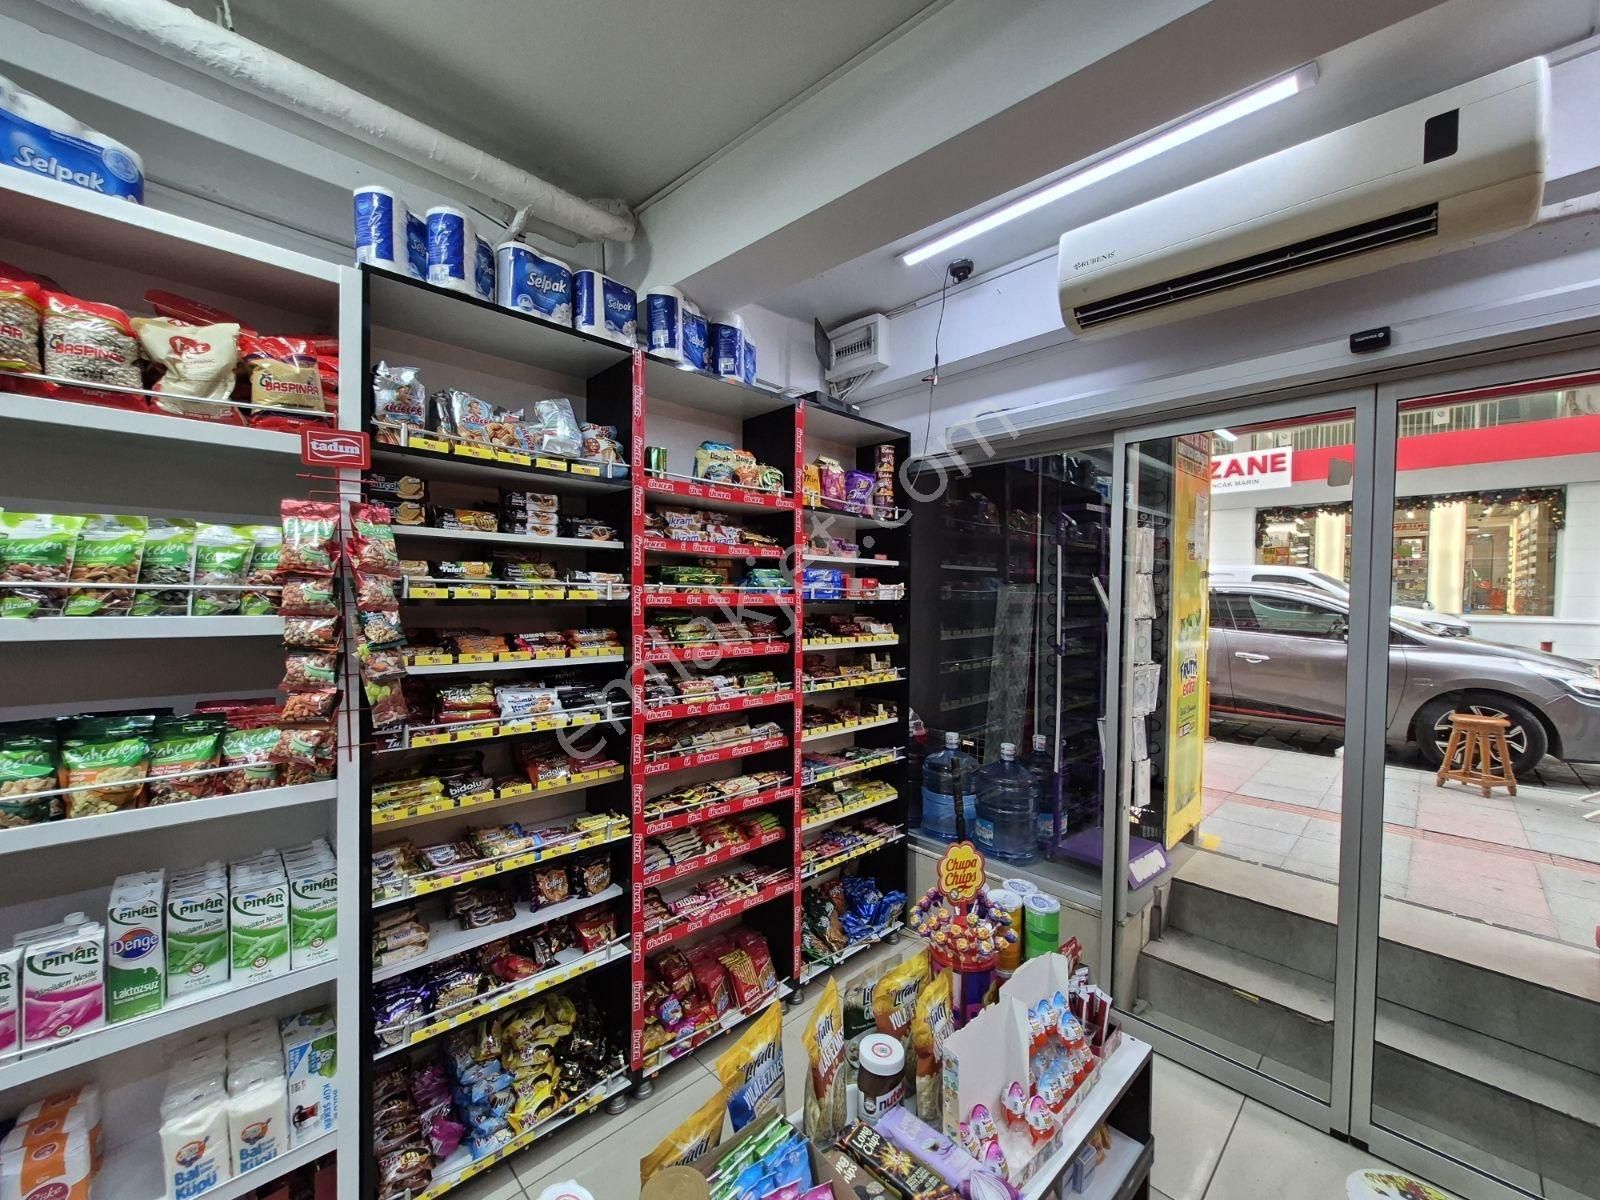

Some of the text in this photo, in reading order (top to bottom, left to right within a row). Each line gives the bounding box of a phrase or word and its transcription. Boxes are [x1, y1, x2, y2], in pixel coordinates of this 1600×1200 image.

[12, 145, 105, 192] Selpak
[526, 272, 567, 294] Selpak
[608, 299, 632, 312] Selpak
[634, 436, 642, 467] ÜLKER
[1211, 453, 1287, 479] ZANE
[648, 479, 674, 491] ÜLKER
[635, 485, 643, 516] ÜLKER
[709, 488, 731, 500] ÜLKER
[744, 495, 764, 504] ÜLKER
[634, 535, 642, 566] ÜLKER
[693, 543, 715, 552] ÜLKER
[728, 546, 749, 555] ÜLKER
[634, 586, 642, 616] ÜLKER
[646, 594, 672, 604] ÜLKER
[646, 652, 669, 661] ÜLKER
[697, 649, 720, 657] ÜLKER
[708, 703, 730, 712] ÜLKER
[743, 698, 763, 706] ÜLKER
[647, 710, 672, 721] ÜLKER
[634, 734, 643, 765] ÜLKER
[732, 746, 752, 756] ÜLKER
[697, 753, 719, 763] ÜLKER
[644, 763, 669, 774] ÜLKER
[449, 781, 482, 796] bidolu
[634, 783, 643, 814] ÜLKER
[708, 805, 730, 817] ÜLKER
[647, 821, 672, 834] ÜLKER
[634, 833, 643, 864] ÜLKER
[730, 843, 750, 855] ÜLKER
[675, 861, 699, 875] ÜLKER
[946, 858, 977, 875] Chupa
[945, 871, 977, 888] Chups
[634, 882, 642, 913] ÜLKER
[709, 909, 731, 923] ÜLKER
[112, 934, 159, 954] Denge
[634, 932, 642, 963] ÜLKER
[647, 933, 672, 949] ÜLKER
[113, 979, 160, 1000] Laktozsuz
[634, 981, 642, 1012] ÜLKER
[633, 1030, 642, 1061] ÜLKER
[852, 1126, 873, 1148] Long
[862, 1132, 880, 1155] Chips
[239, 1143, 263, 1161] Bal
[174, 1163, 201, 1187] Bal
